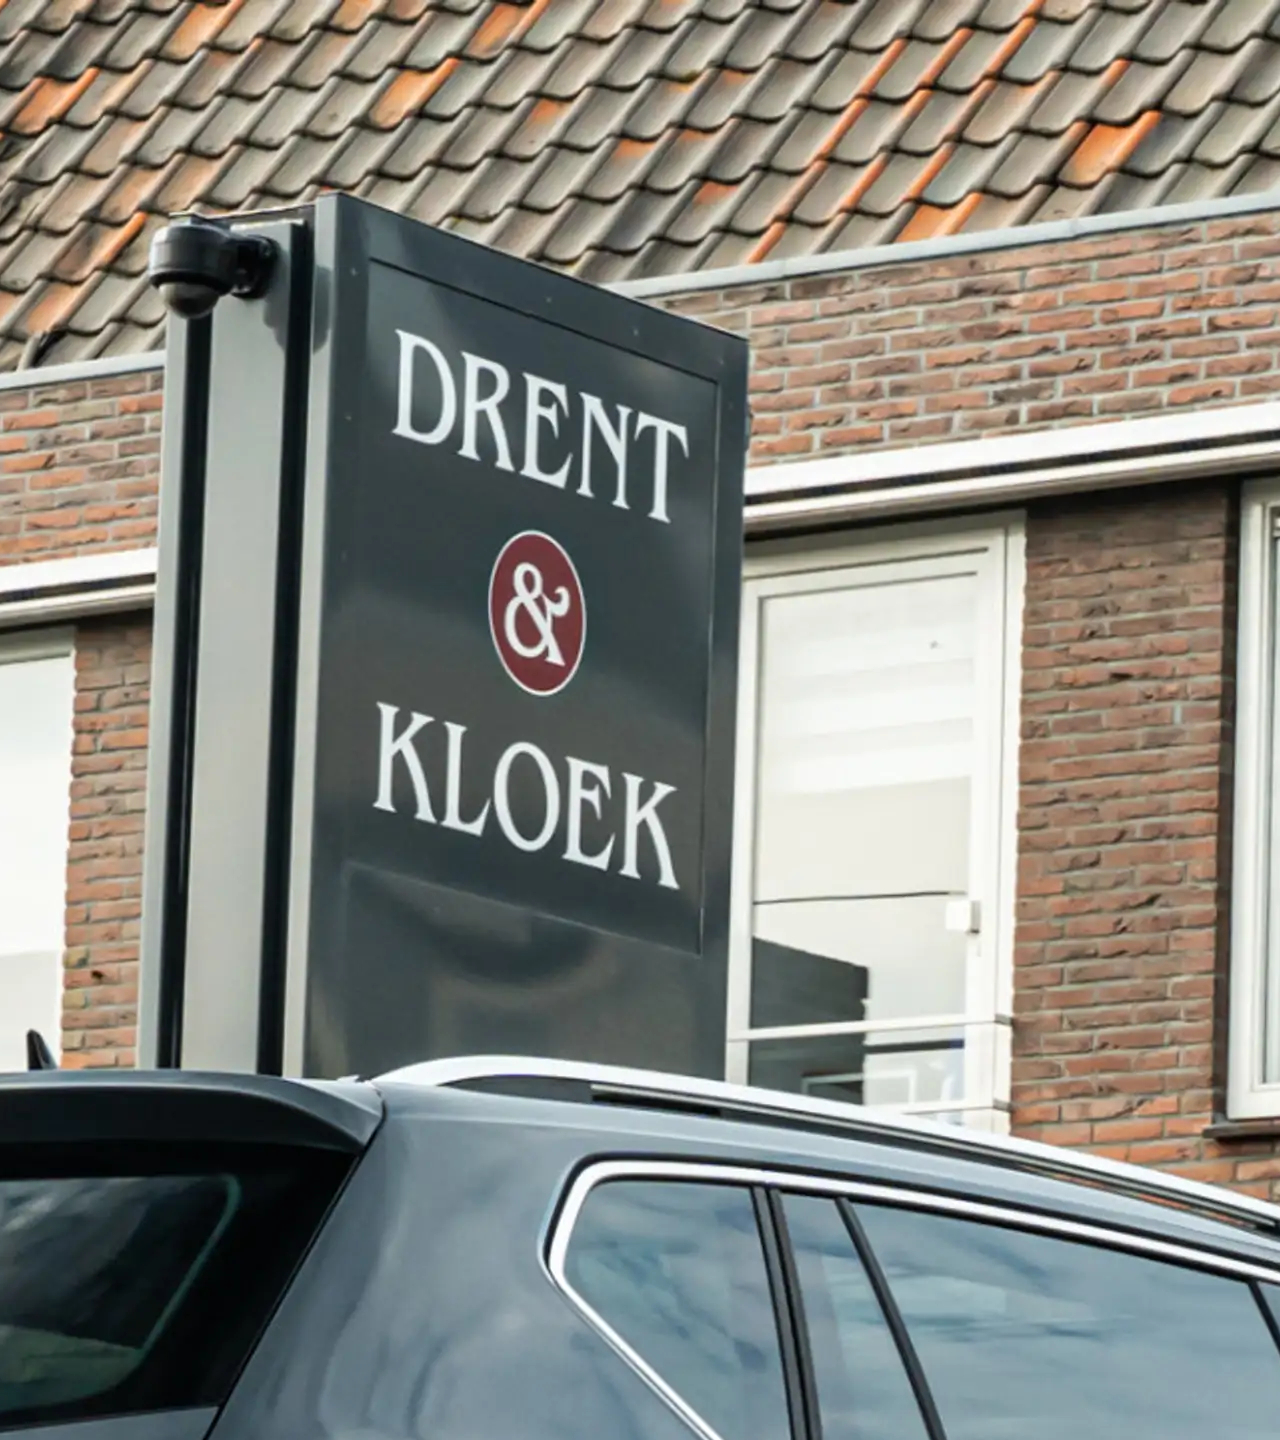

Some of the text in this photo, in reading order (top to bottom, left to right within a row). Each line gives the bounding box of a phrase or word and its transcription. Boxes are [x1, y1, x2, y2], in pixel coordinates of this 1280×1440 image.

[391, 328, 690, 524] DRENT
[504, 562, 570, 667] &
[372, 701, 681, 890] KLOEK
